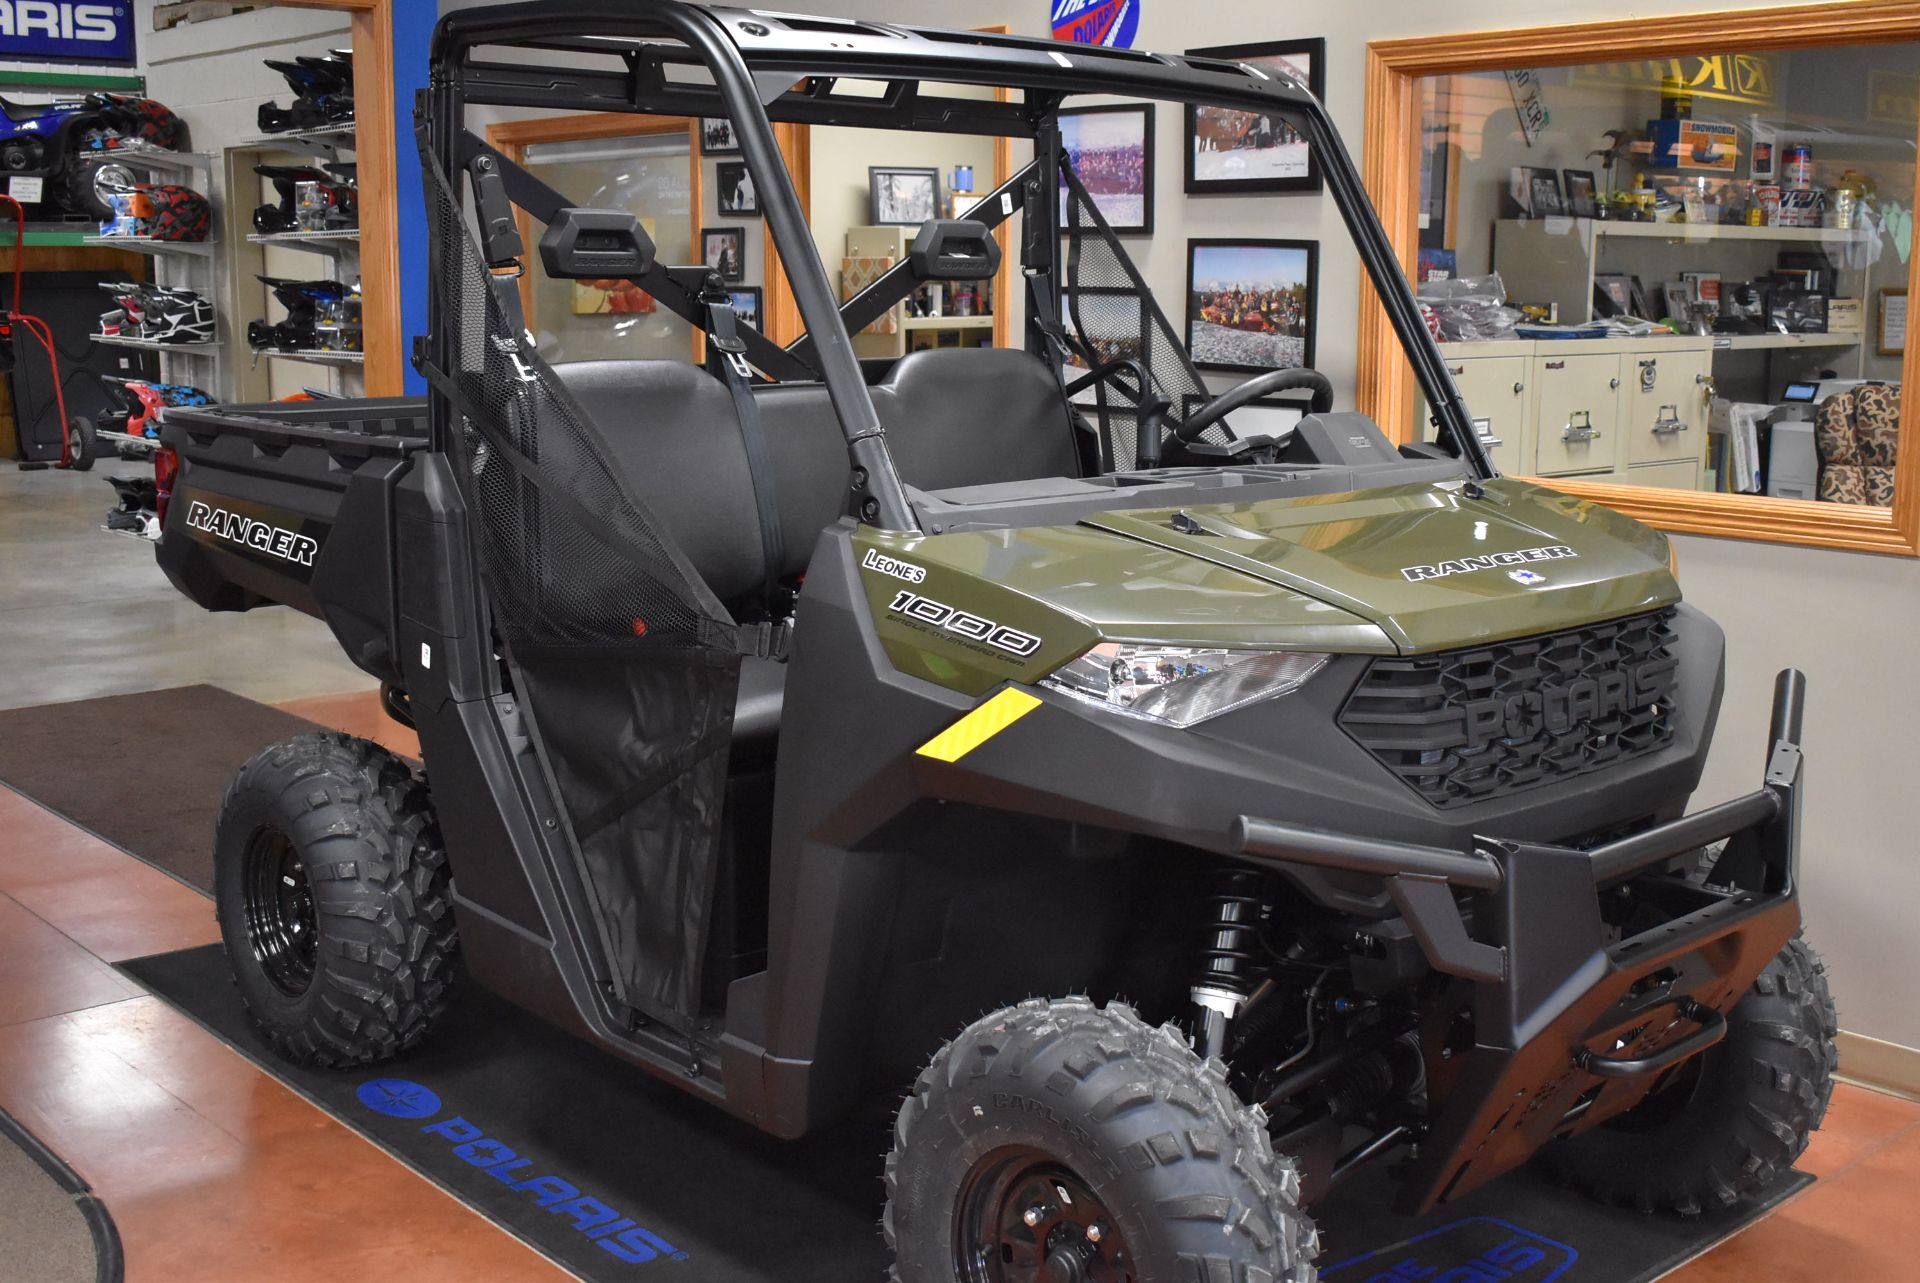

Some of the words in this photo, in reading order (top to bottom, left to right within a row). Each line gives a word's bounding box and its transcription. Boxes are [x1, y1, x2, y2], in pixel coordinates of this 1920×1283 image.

[186, 500, 318, 567] RANGER
[863, 550, 926, 583] LEONE'S
[1400, 545, 1579, 582] RANGER
[885, 614, 928, 632] SINGLE
[931, 631, 996, 657] OVERHEAD
[996, 654, 1026, 667] CAM
[888, 590, 1042, 658] 1000
[1465, 658, 1680, 748] POLARIS
[420, 1115, 681, 1264] POLARIS
